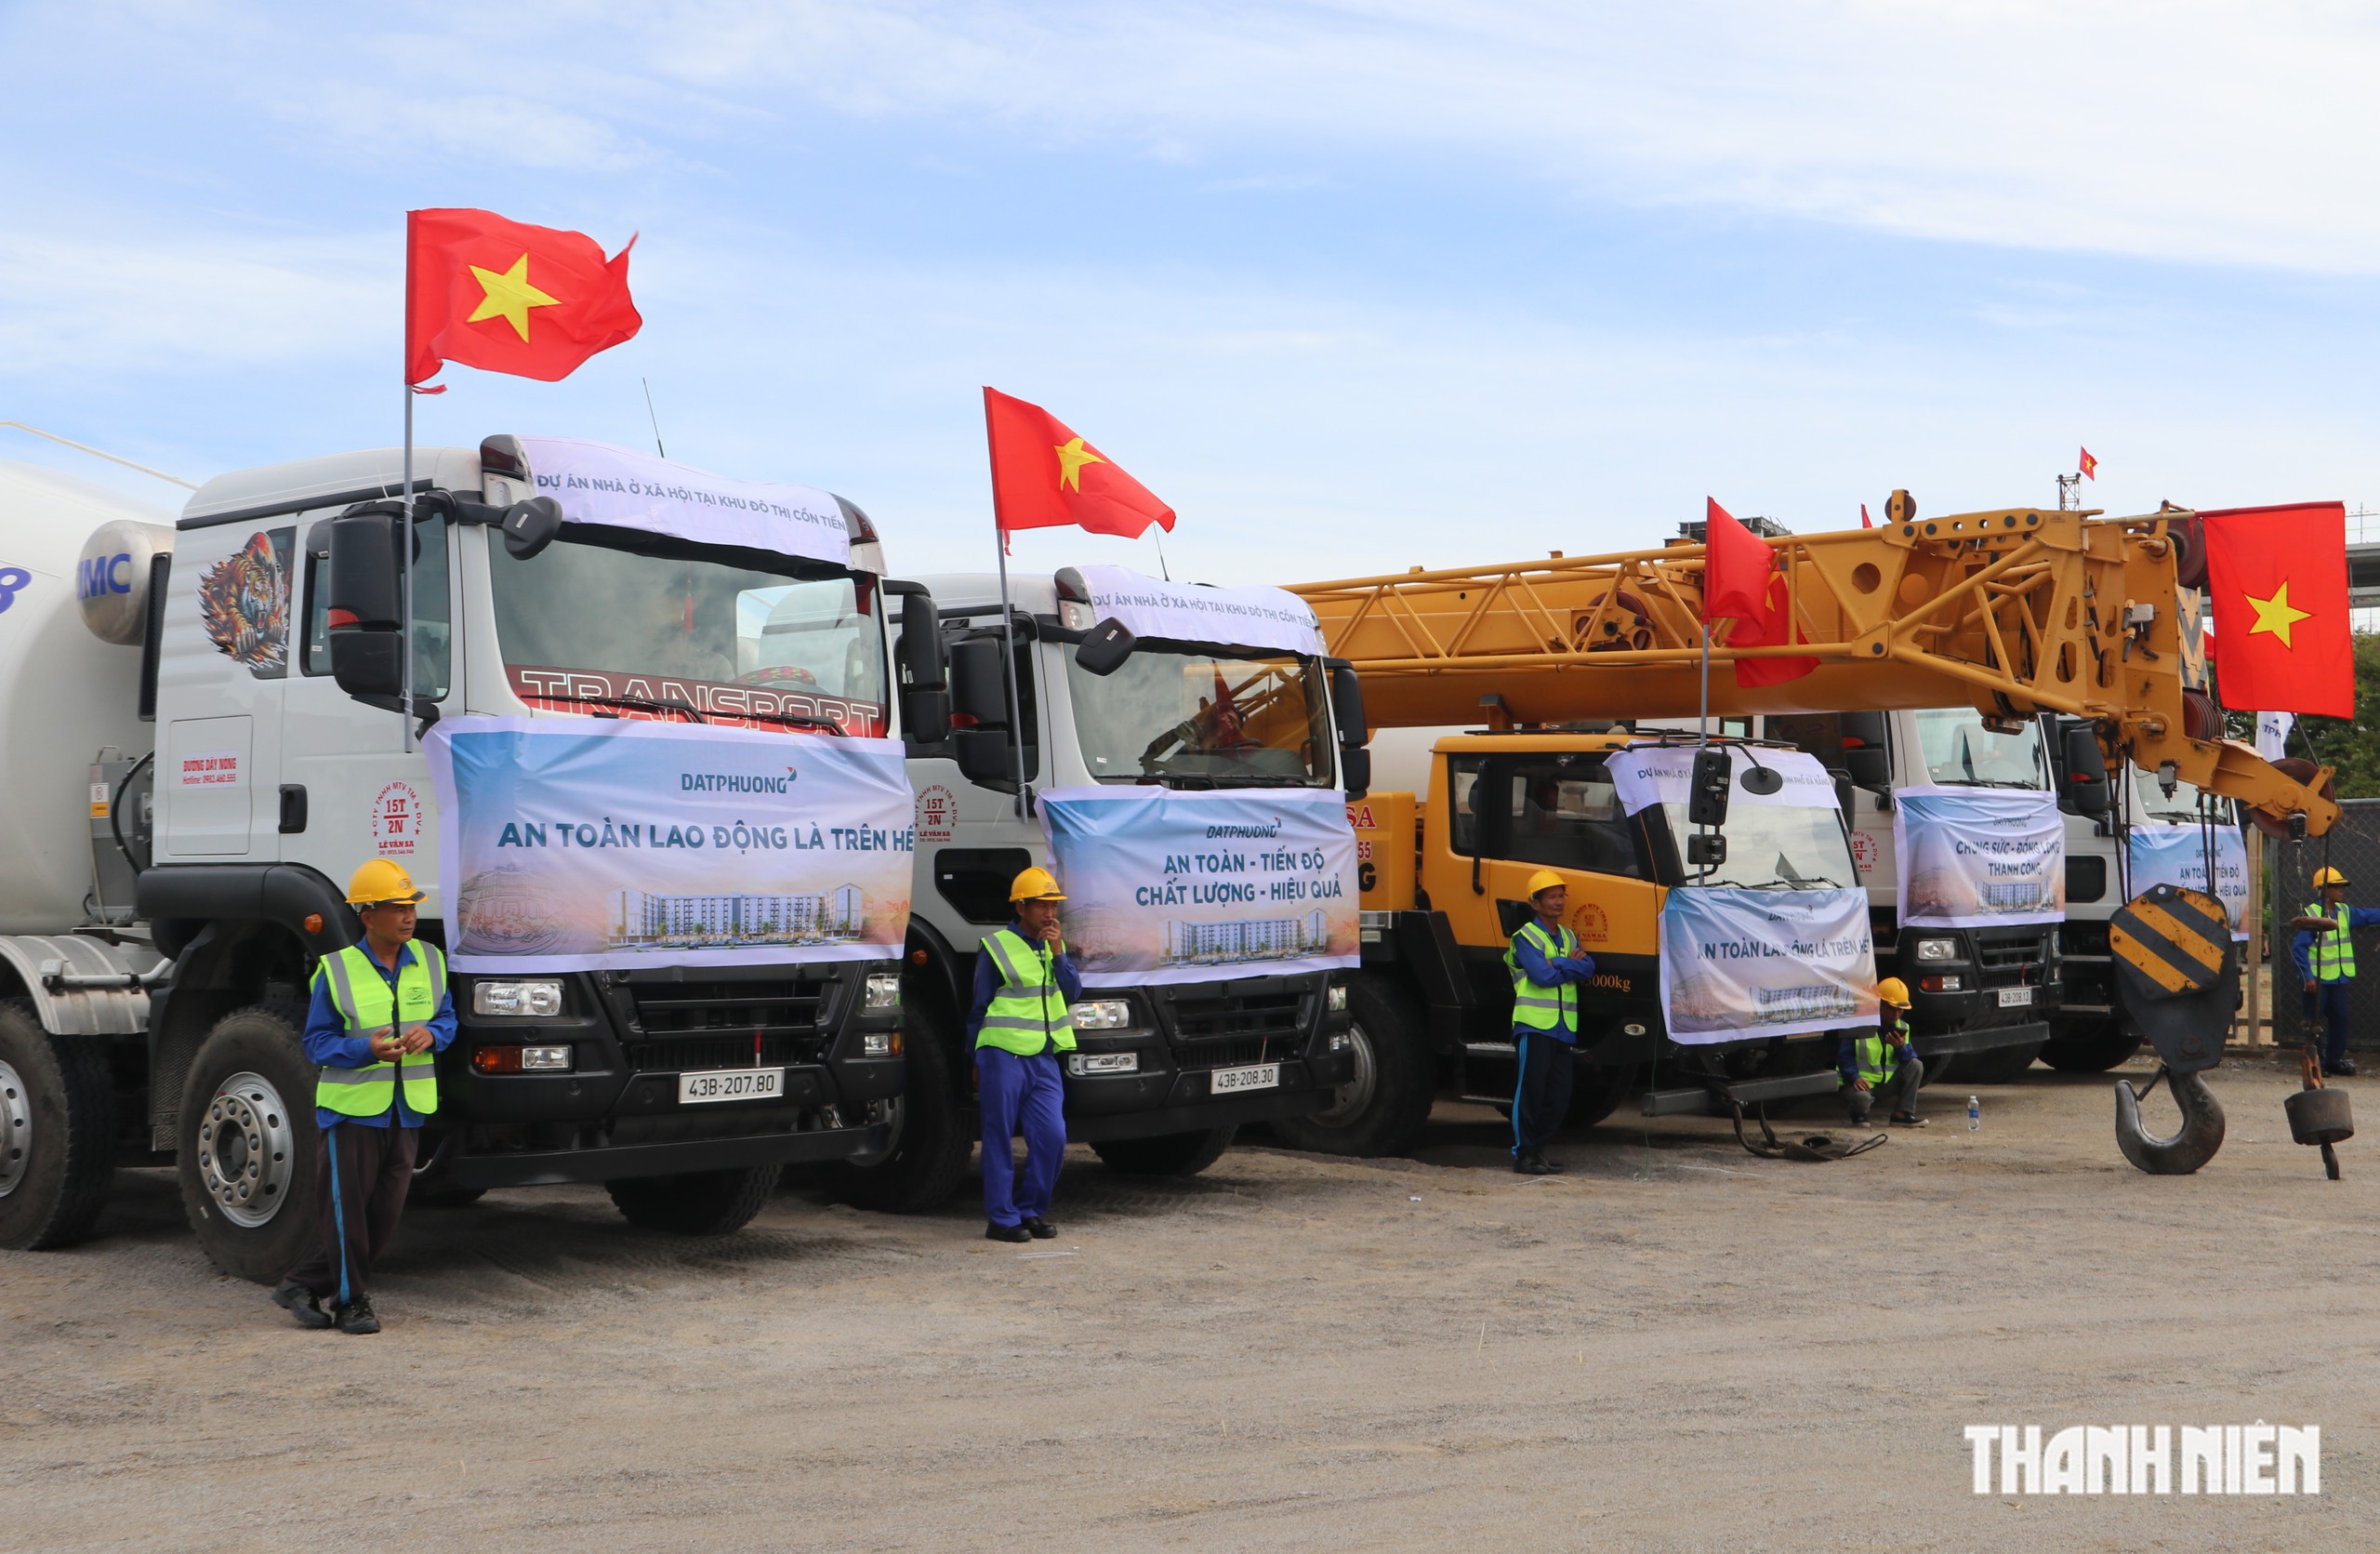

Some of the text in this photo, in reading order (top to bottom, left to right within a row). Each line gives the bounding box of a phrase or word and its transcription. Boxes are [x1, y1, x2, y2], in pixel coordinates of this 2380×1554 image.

[537, 473, 846, 532] DỰ ÁN NHÀ Ở XÃ HỘI TẠI KHU ĐÔ THỊ CỒN TIẾN
[521, 670, 879, 737] TRANSPORT
[681, 773, 787, 793] DATPHUONG
[376, 785, 391, 805] TNHH
[392, 782, 407, 790] MTV
[386, 799, 405, 813] 15T
[927, 799, 944, 809] 15T
[389, 819, 403, 833] 2N
[928, 815, 941, 825] 2N
[497, 817, 915, 855] AN TOÀN LAO ĐỘNG LÀ TRÊN HẾ
[1207, 825, 1277, 839] DATPHUONG
[1854, 841, 1864, 849] 5T
[1164, 855, 1191, 874] AN
[1195, 849, 1245, 873] TOÀN
[1261, 844, 1297, 871] TIẾN
[1301, 847, 1325, 874] ĐỘ
[1856, 852, 1862, 860] N
[2180, 868, 2190, 880] AN
[2192, 864, 2207, 879] TOÀ
[2229, 864, 2240, 881] ĐỘ
[1135, 877, 1187, 906] CHẤT
[1193, 882, 1255, 908] LƯỢNG
[1270, 877, 1305, 904] HIỆU
[1310, 872, 1342, 899] QUẢ
[2232, 880, 2246, 897] QUẢ
[1720, 937, 1760, 959] TOÀN
[1830, 936, 1858, 957] TRÊN
[689, 1074, 774, 1096] 43B-207.80
[1218, 1069, 1273, 1088] 43B-208.30
